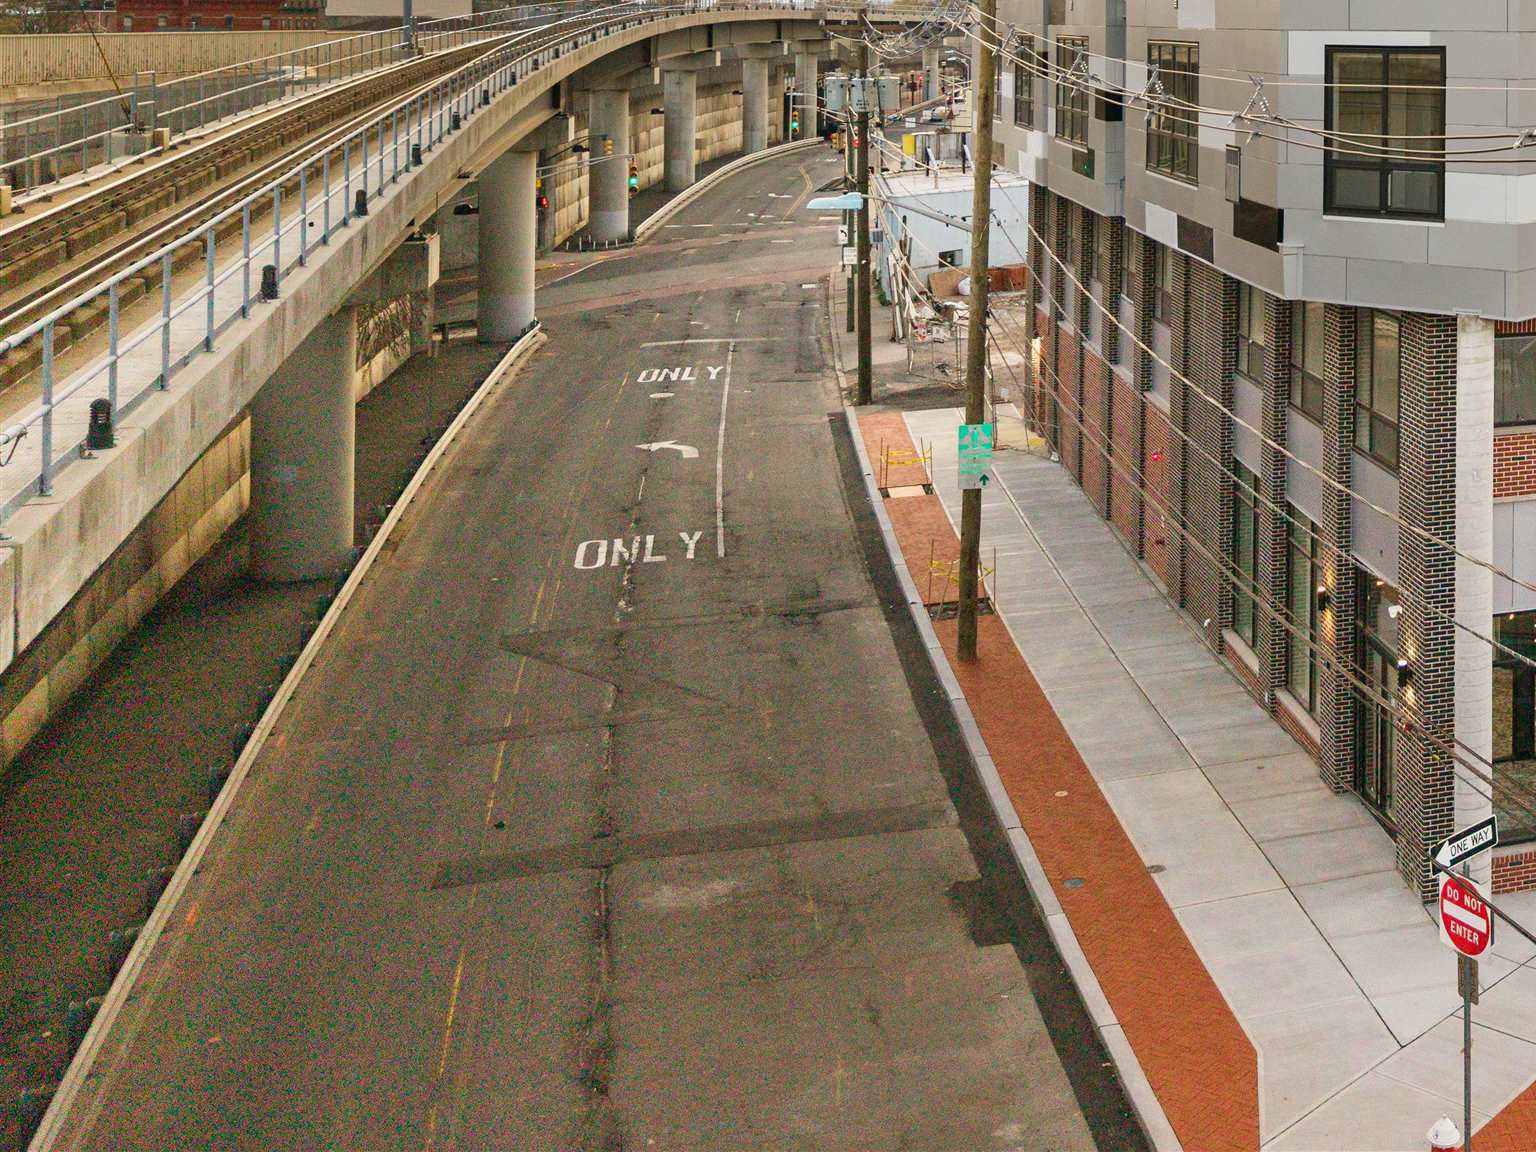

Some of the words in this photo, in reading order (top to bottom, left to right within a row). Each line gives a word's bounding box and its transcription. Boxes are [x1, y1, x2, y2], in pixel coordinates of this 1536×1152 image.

[637, 366, 724, 383] ONLY
[574, 530, 702, 570] ONLY
[1450, 840, 1468, 857] ONE
[1471, 828, 1490, 846] WAY
[1446, 886, 1458, 902] DO
[1464, 894, 1483, 913] NOT
[1450, 920, 1479, 945] ENTER
